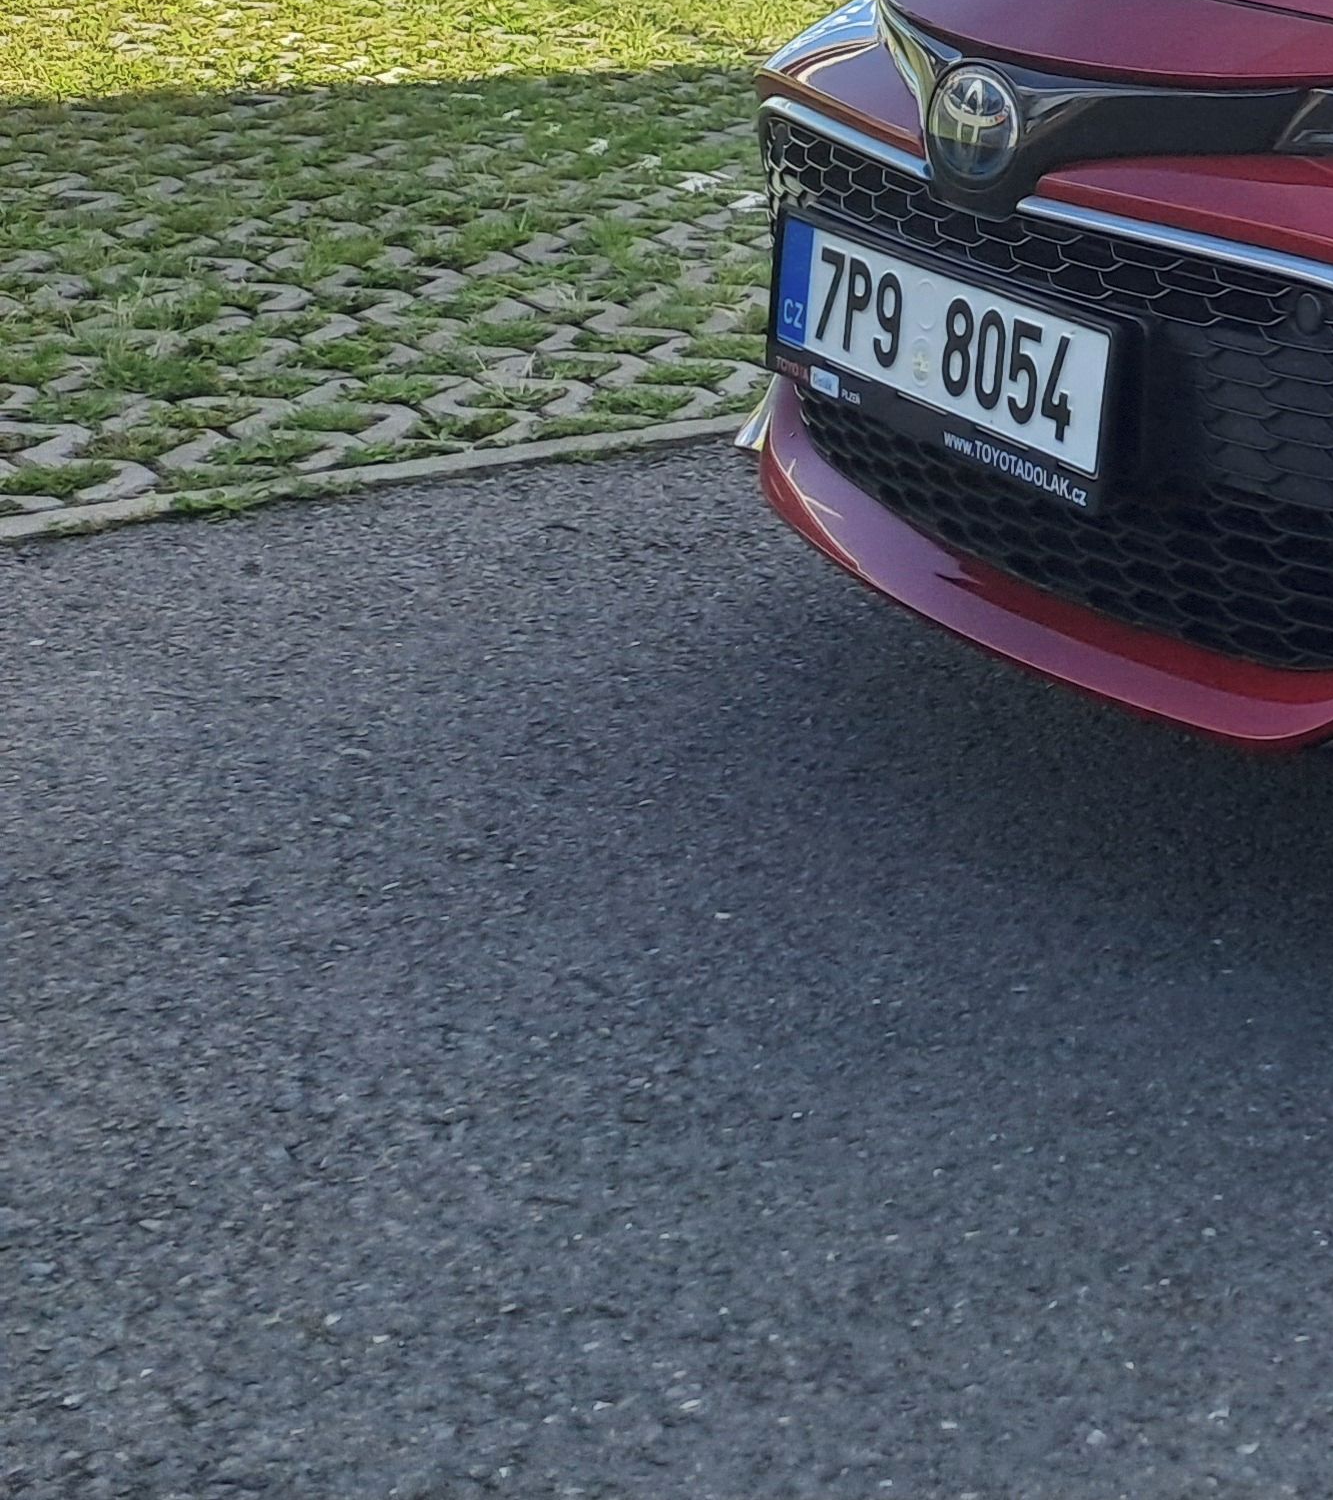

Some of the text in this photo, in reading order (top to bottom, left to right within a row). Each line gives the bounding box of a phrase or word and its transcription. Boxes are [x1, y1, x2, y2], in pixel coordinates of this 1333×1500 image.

[783, 298, 805, 329] CZ
[776, 355, 809, 382] TOYOTA
[814, 246, 1073, 444] 7P9 8054
[943, 430, 1087, 507] www.TOYOTADOLAK.cz
